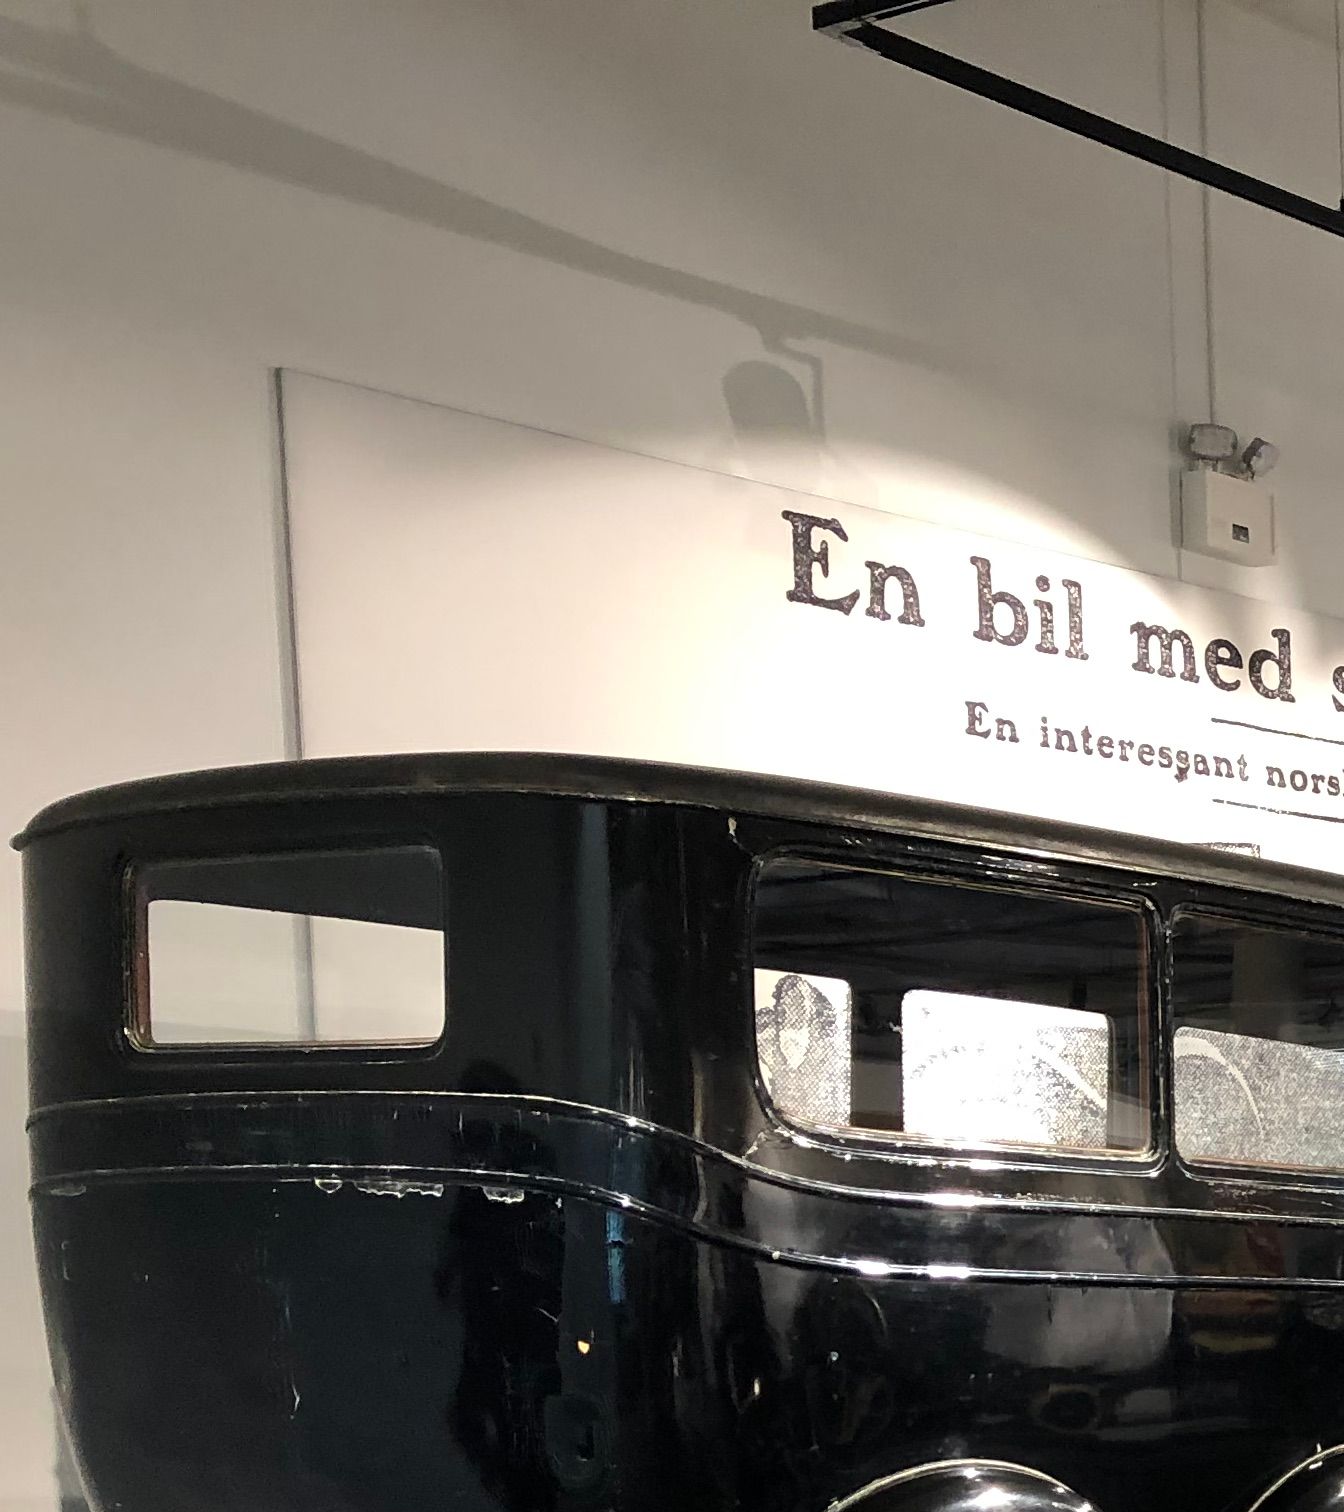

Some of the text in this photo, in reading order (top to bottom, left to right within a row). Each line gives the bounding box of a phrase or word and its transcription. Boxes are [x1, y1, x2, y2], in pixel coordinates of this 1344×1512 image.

[782, 510, 925, 627] En
[970, 555, 1088, 660] bil
[1130, 621, 1295, 703] med
[965, 701, 1019, 743] En
[1040, 716, 1248, 783] interessant
